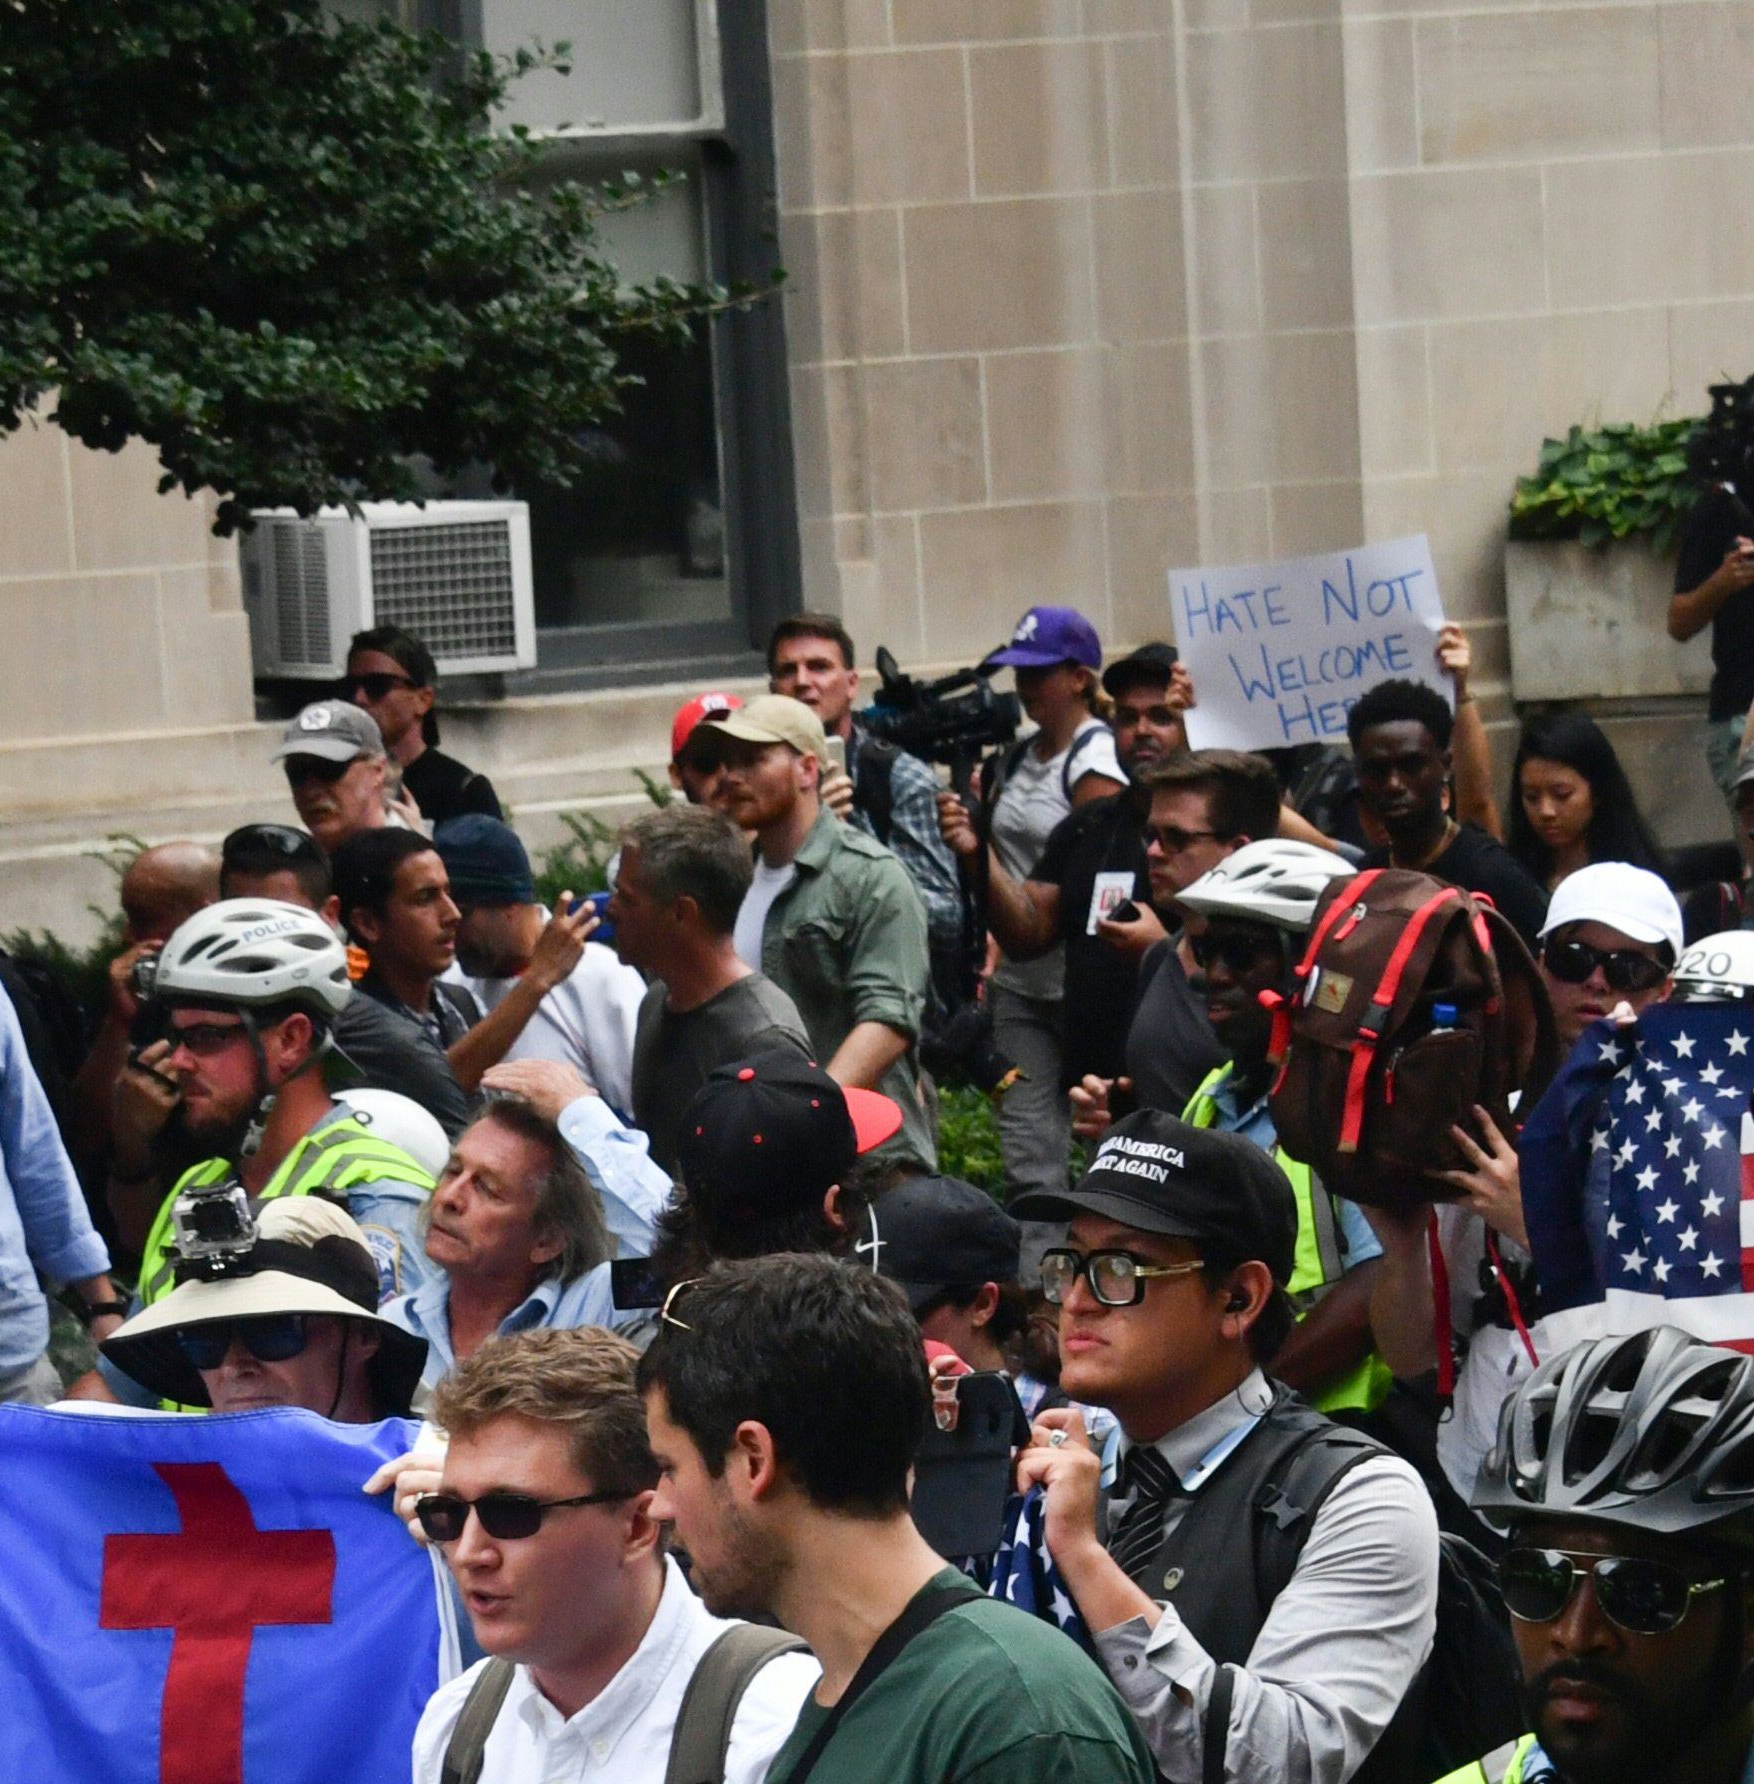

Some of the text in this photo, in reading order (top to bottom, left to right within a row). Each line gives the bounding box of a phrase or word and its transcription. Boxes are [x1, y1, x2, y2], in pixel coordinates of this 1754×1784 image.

[1183, 557, 1425, 638] HATE NOT
[1228, 633, 1413, 702] WELCOME
[242, 918, 302, 943] POLICE
[1112, 1158, 1170, 1185] AGAIN
